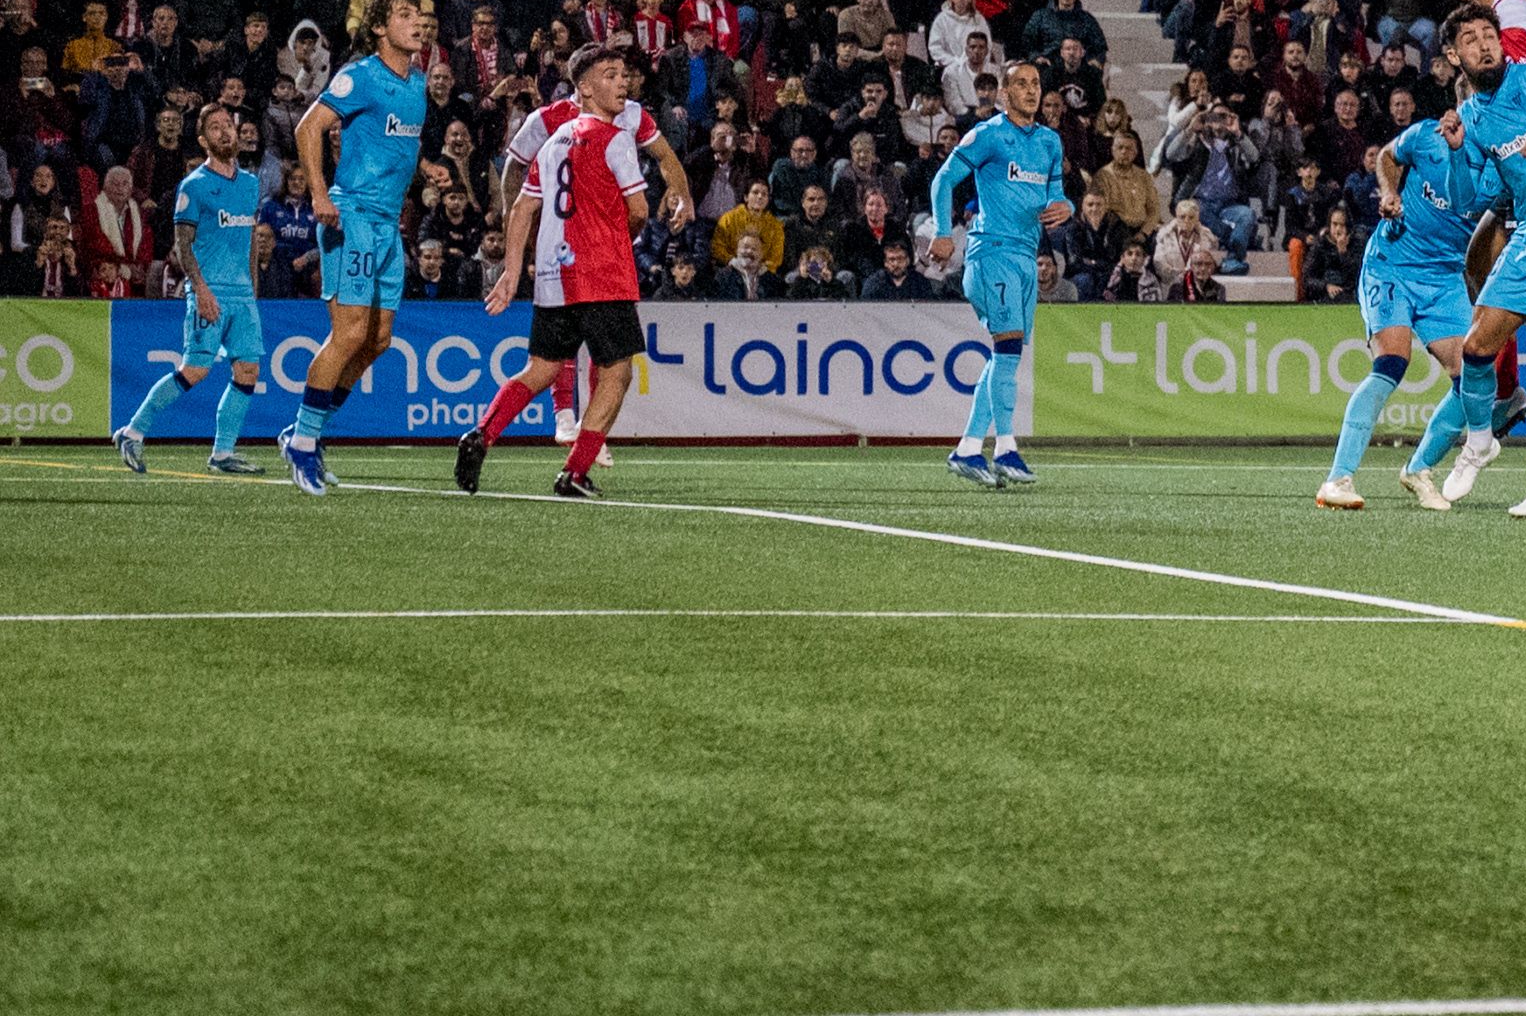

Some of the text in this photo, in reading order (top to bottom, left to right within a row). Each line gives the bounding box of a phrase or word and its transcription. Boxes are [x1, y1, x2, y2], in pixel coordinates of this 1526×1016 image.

[554, 157, 577, 220] 8
[346, 250, 374, 278] 30
[995, 282, 1007, 306] 7
[1368, 282, 1396, 308] 27
[0, 334, 75, 392] o
[704, 322, 992, 396] lainco
[407, 397, 544, 431] phara
